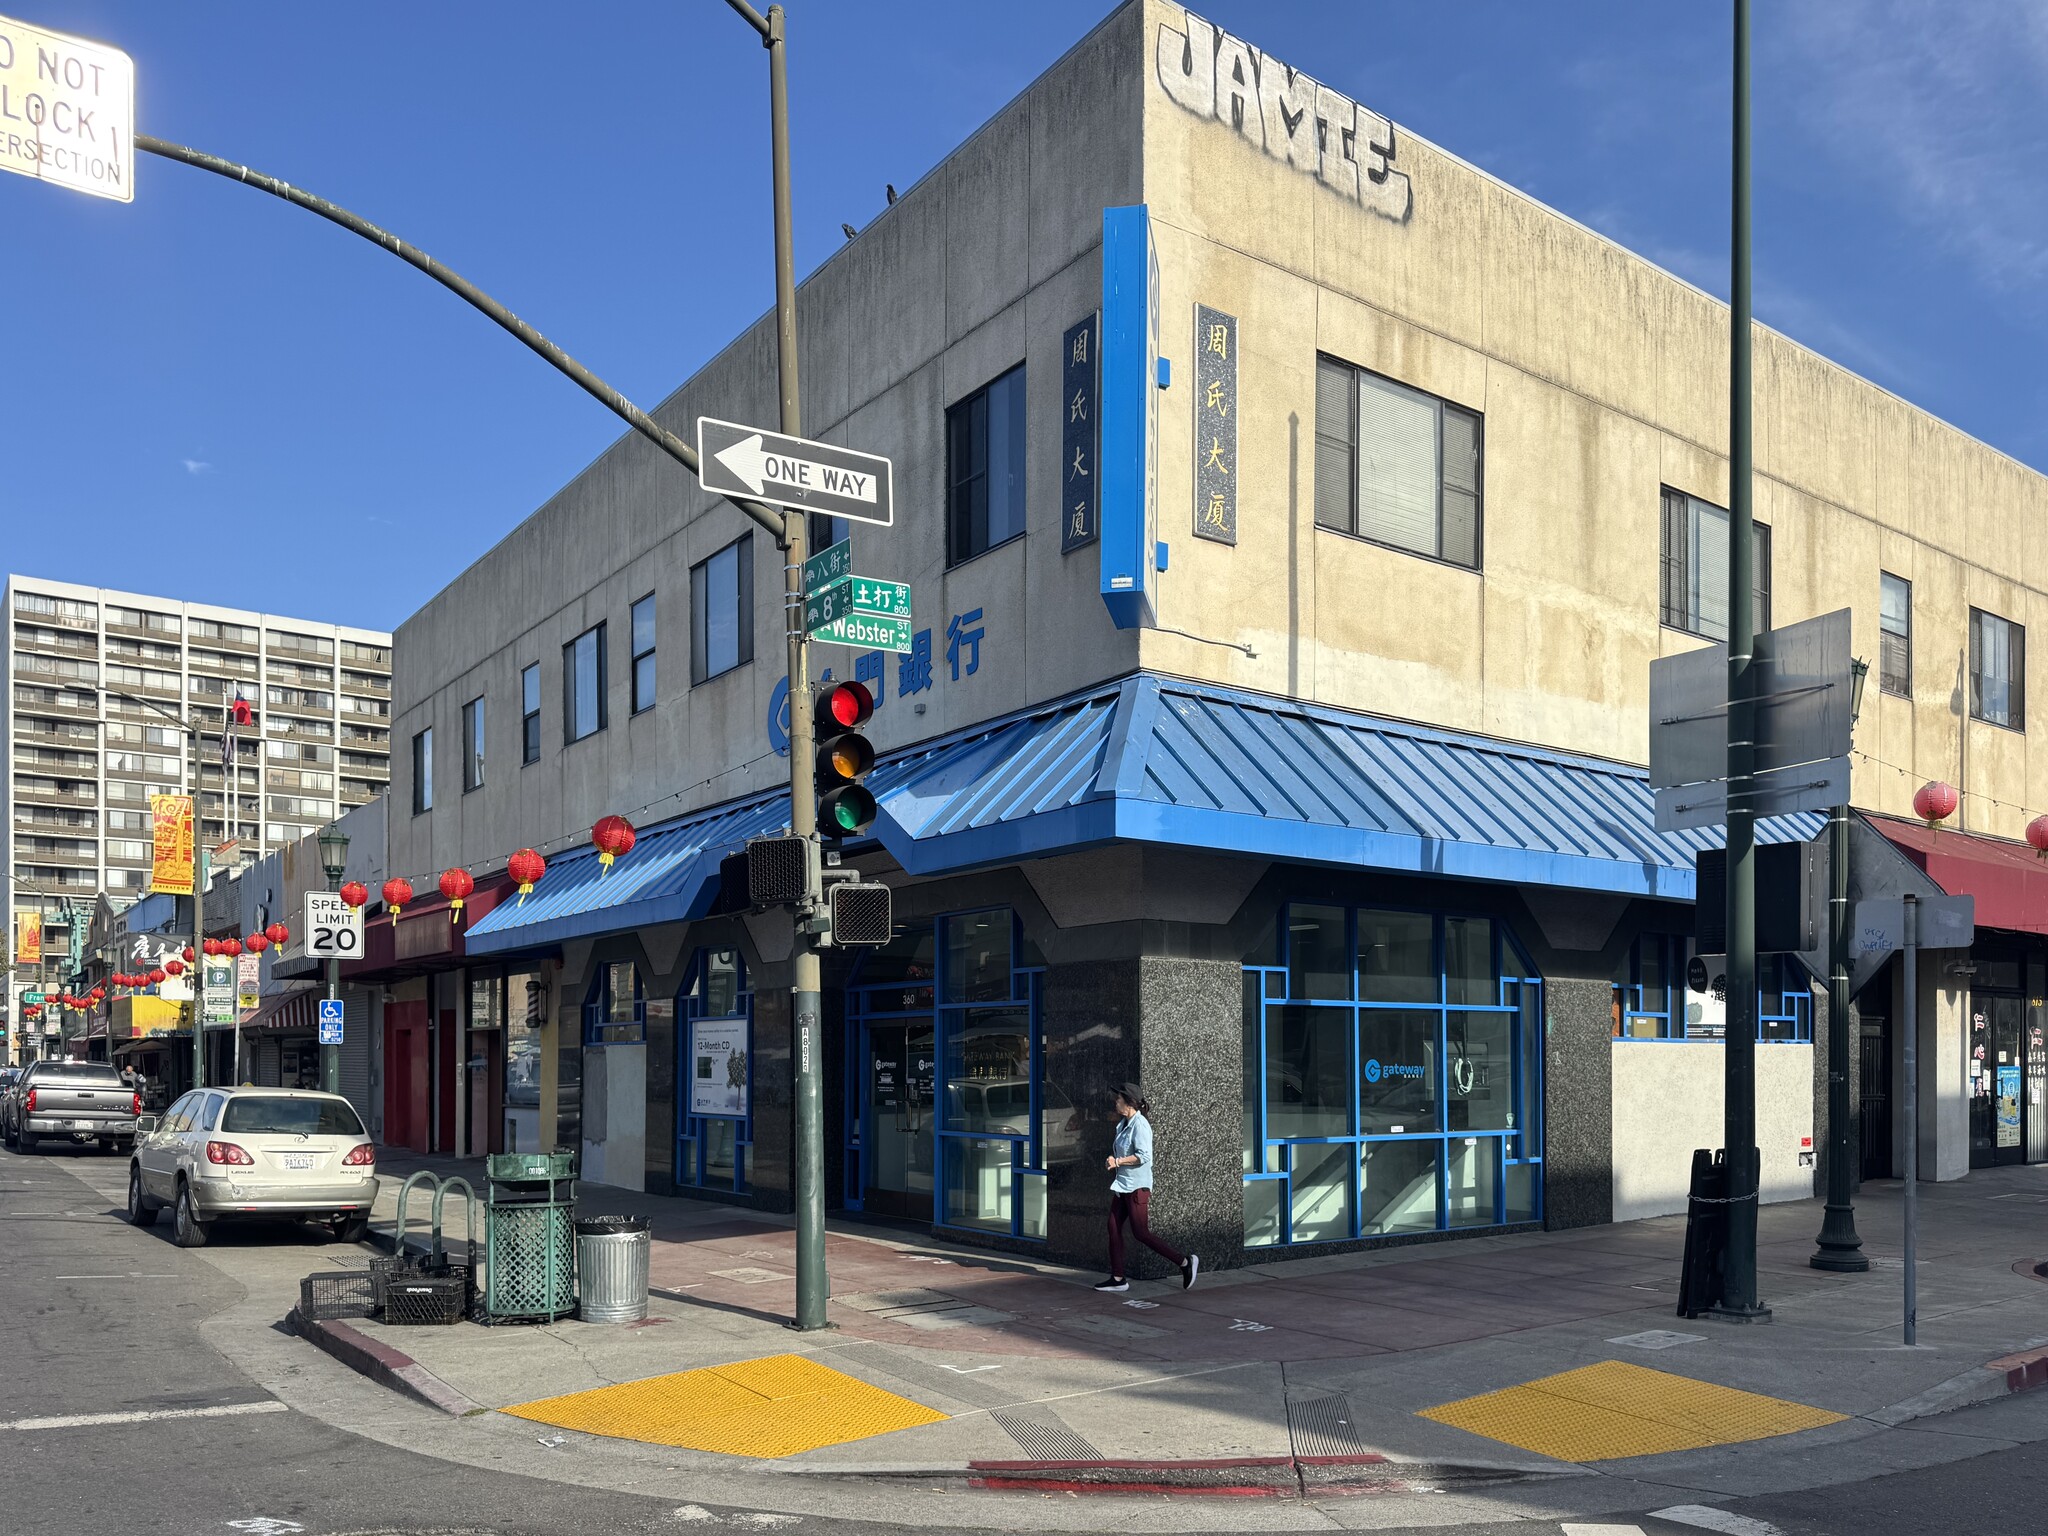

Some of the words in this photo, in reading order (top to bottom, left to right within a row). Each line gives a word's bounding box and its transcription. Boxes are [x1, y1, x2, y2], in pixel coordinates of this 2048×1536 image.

[38, 47, 105, 96] NOT
[765, 456, 811, 486] ONE
[823, 469, 867, 497] WAY
[841, 583, 849, 594] ST
[823, 592, 838, 620] 8th
[841, 604, 852, 616] 350
[893, 606, 909, 615] 800
[833, 618, 895, 644] Webster
[897, 621, 908, 631] ST
[896, 641, 910, 651] 800
[821, 607, 985, 710] 門銀行
[311, 899, 349, 911] SPEE
[316, 913, 353, 925] LIMIT
[313, 927, 356, 951] 20
[902, 994, 915, 1005] 360
[698, 1041, 721, 1050] 12-Month
[722, 1041, 730, 1050] CD
[1383, 1064, 1424, 1078] gateway
